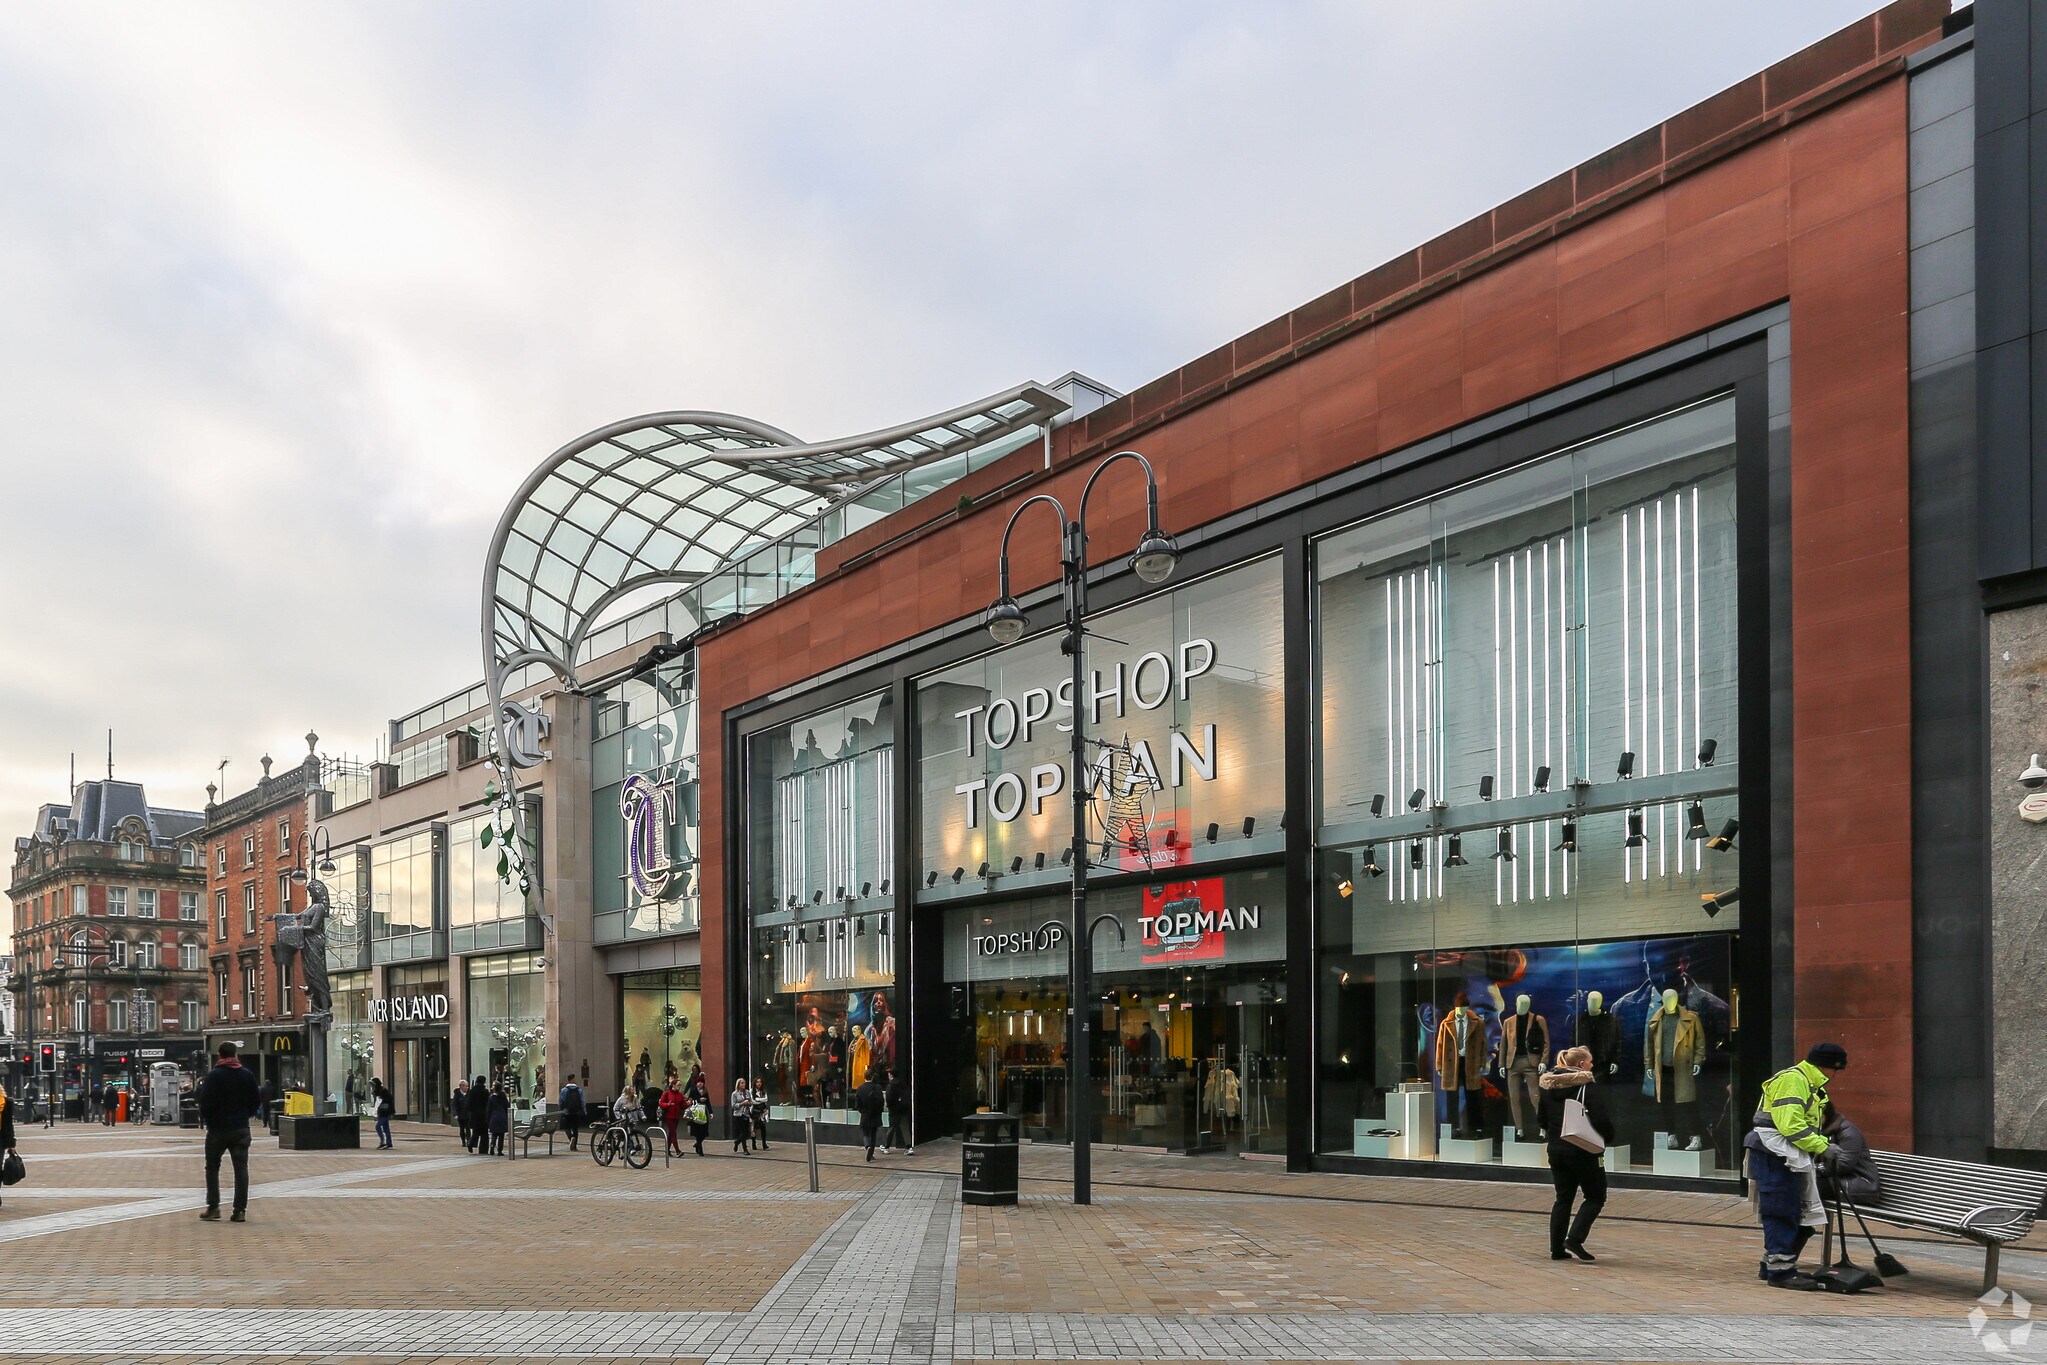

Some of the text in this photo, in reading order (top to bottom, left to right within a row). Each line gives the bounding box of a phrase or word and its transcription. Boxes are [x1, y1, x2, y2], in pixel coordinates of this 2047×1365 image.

[954, 638, 1217, 757] TOPSHOP
[1137, 905, 1260, 939] TOPMAN
[973, 928, 1062, 956] TOPSHOP
[391, 994, 448, 1022] ISLAND
